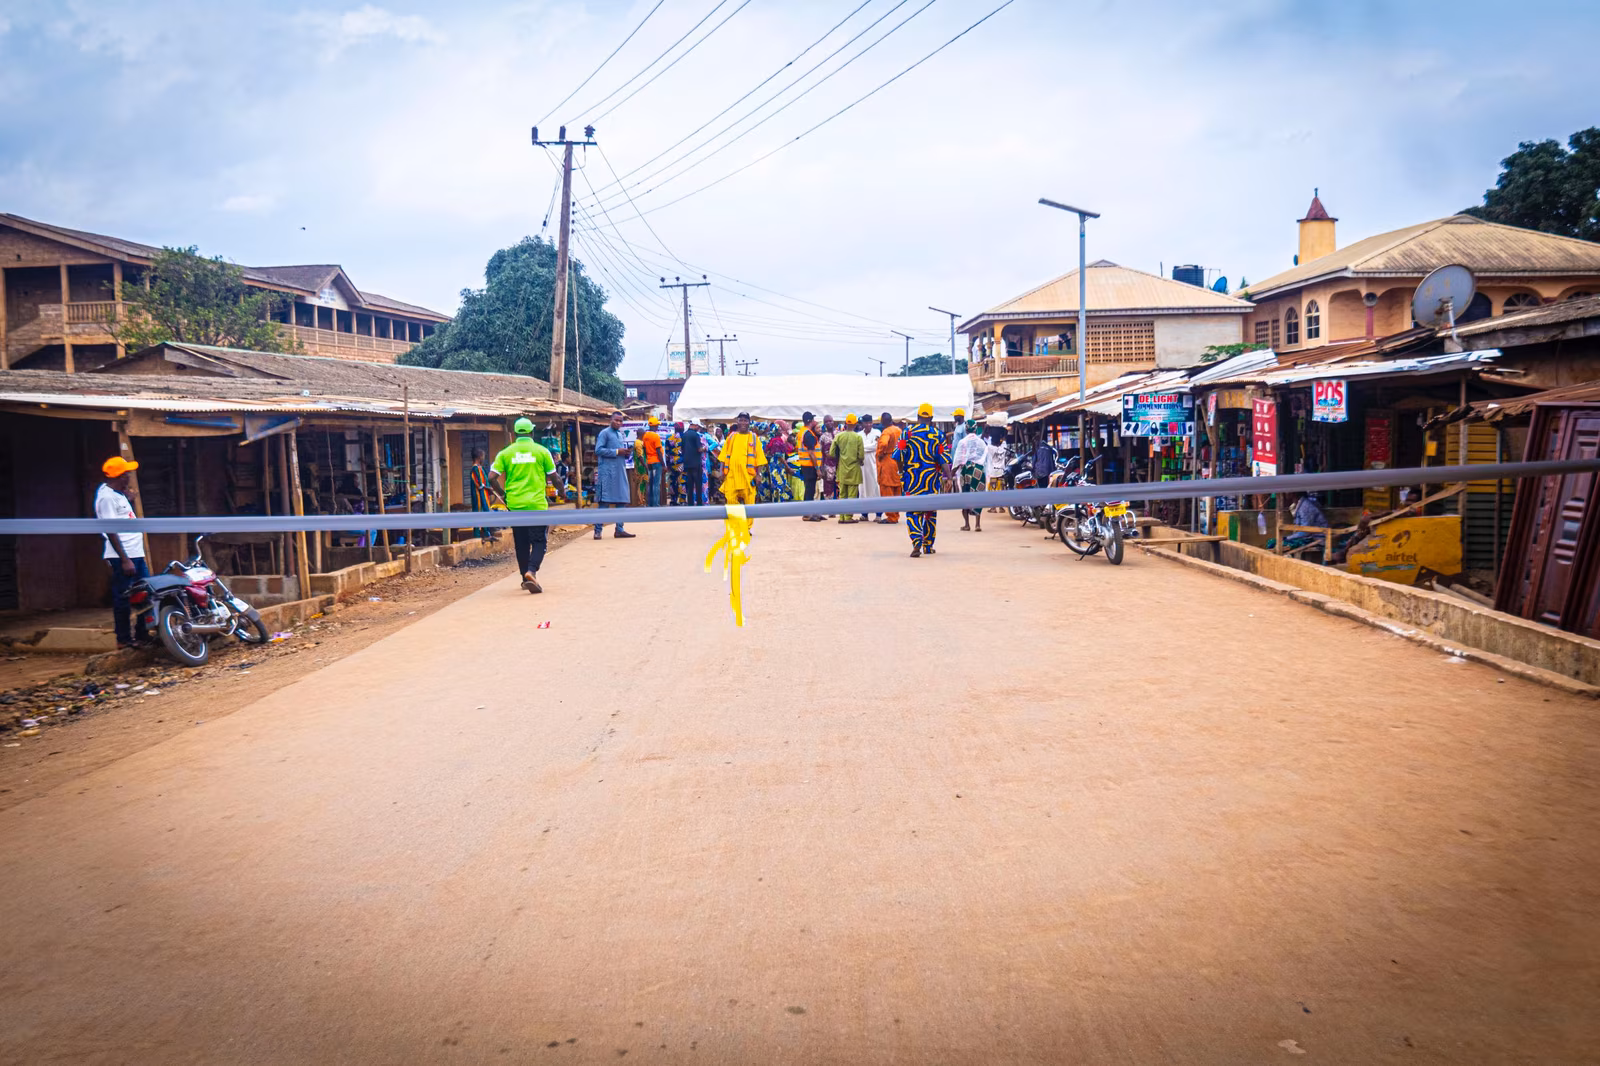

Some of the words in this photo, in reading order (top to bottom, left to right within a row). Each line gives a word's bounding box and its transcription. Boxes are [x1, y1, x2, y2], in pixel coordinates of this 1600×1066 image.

[1315, 380, 1344, 406] POS
[1138, 394, 1150, 404] DE
[1153, 394, 1178, 404] LIGHT
[1385, 552, 1417, 563] airtel
